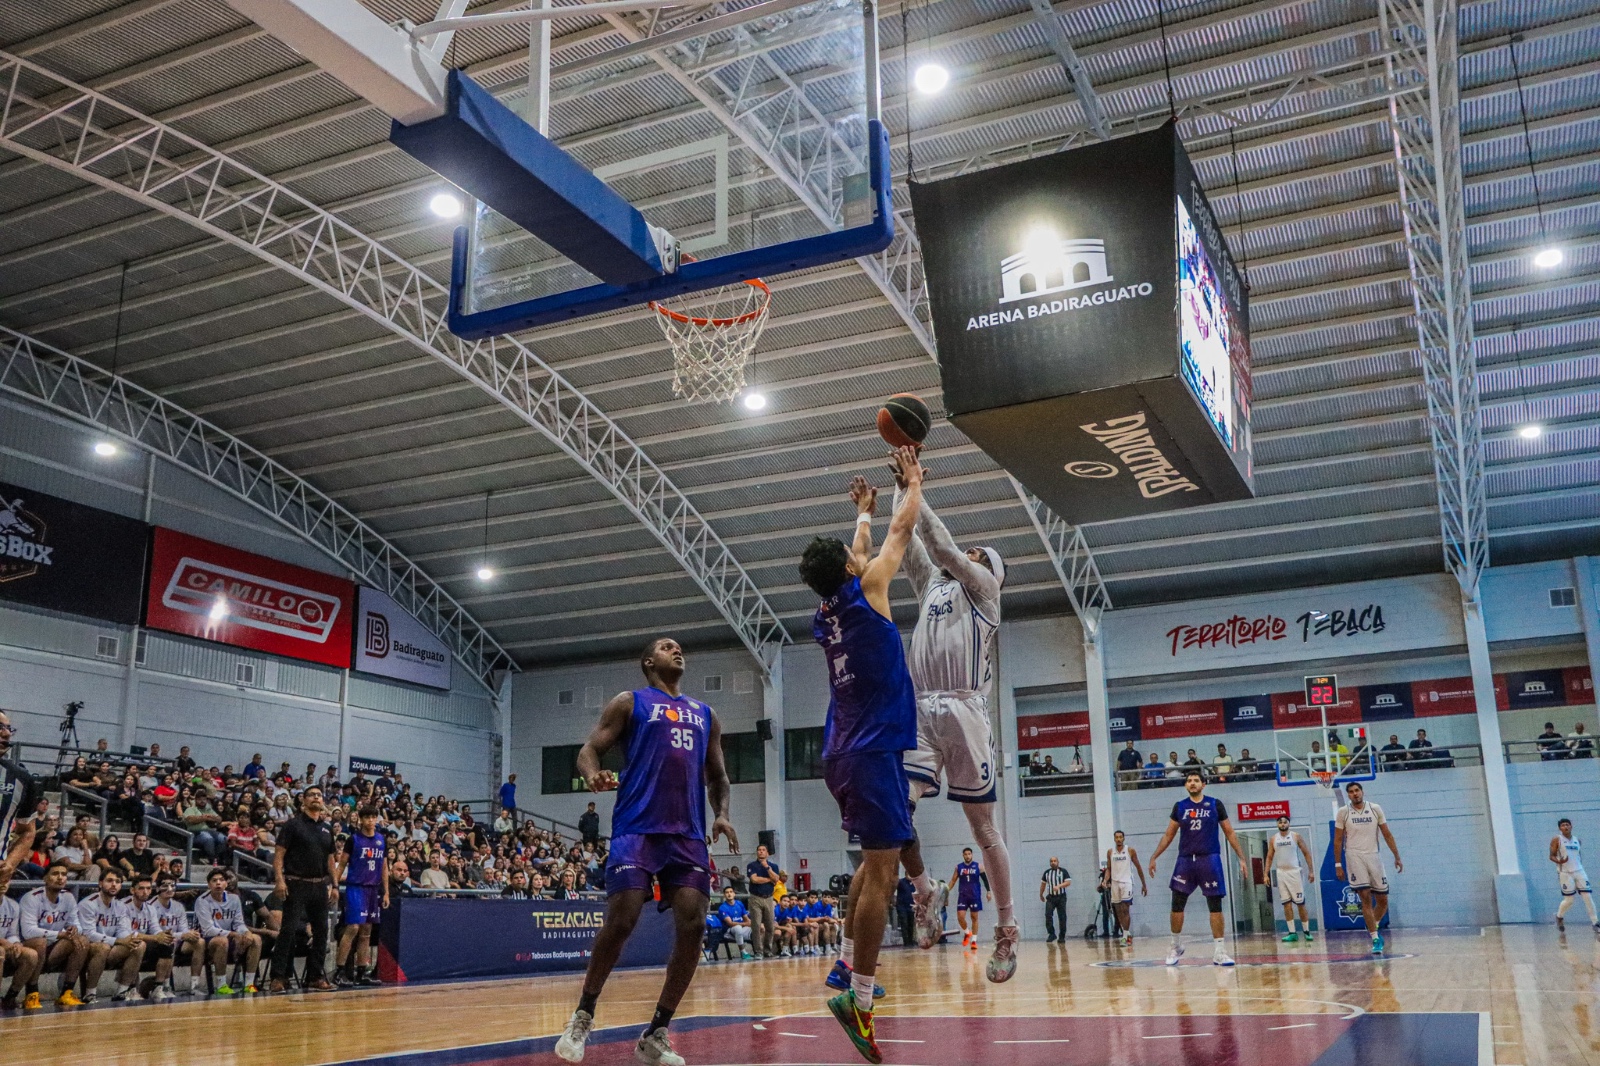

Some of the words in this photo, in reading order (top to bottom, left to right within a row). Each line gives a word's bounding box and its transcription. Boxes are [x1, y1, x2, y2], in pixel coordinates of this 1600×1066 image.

[966, 308, 1024, 331] ARENA
[1027, 282, 1153, 318] BADIRAGUATO
[1079, 411, 1200, 499] SPALDING
[187, 572, 296, 611] CAMILO
[1166, 614, 1287, 657] TERRITORIO
[1296, 604, 1386, 644] TEBACA
[393, 640, 445, 663] Badiraguato
[1311, 685, 1333, 704] 22
[670, 727, 694, 751] 35
[981, 762, 989, 780] 3
[1190, 819, 1202, 830] 23
[367, 860, 376, 871] 18
[532, 912, 604, 928] TEBACAS
[543, 931, 596, 939] BADIRAGUATO
